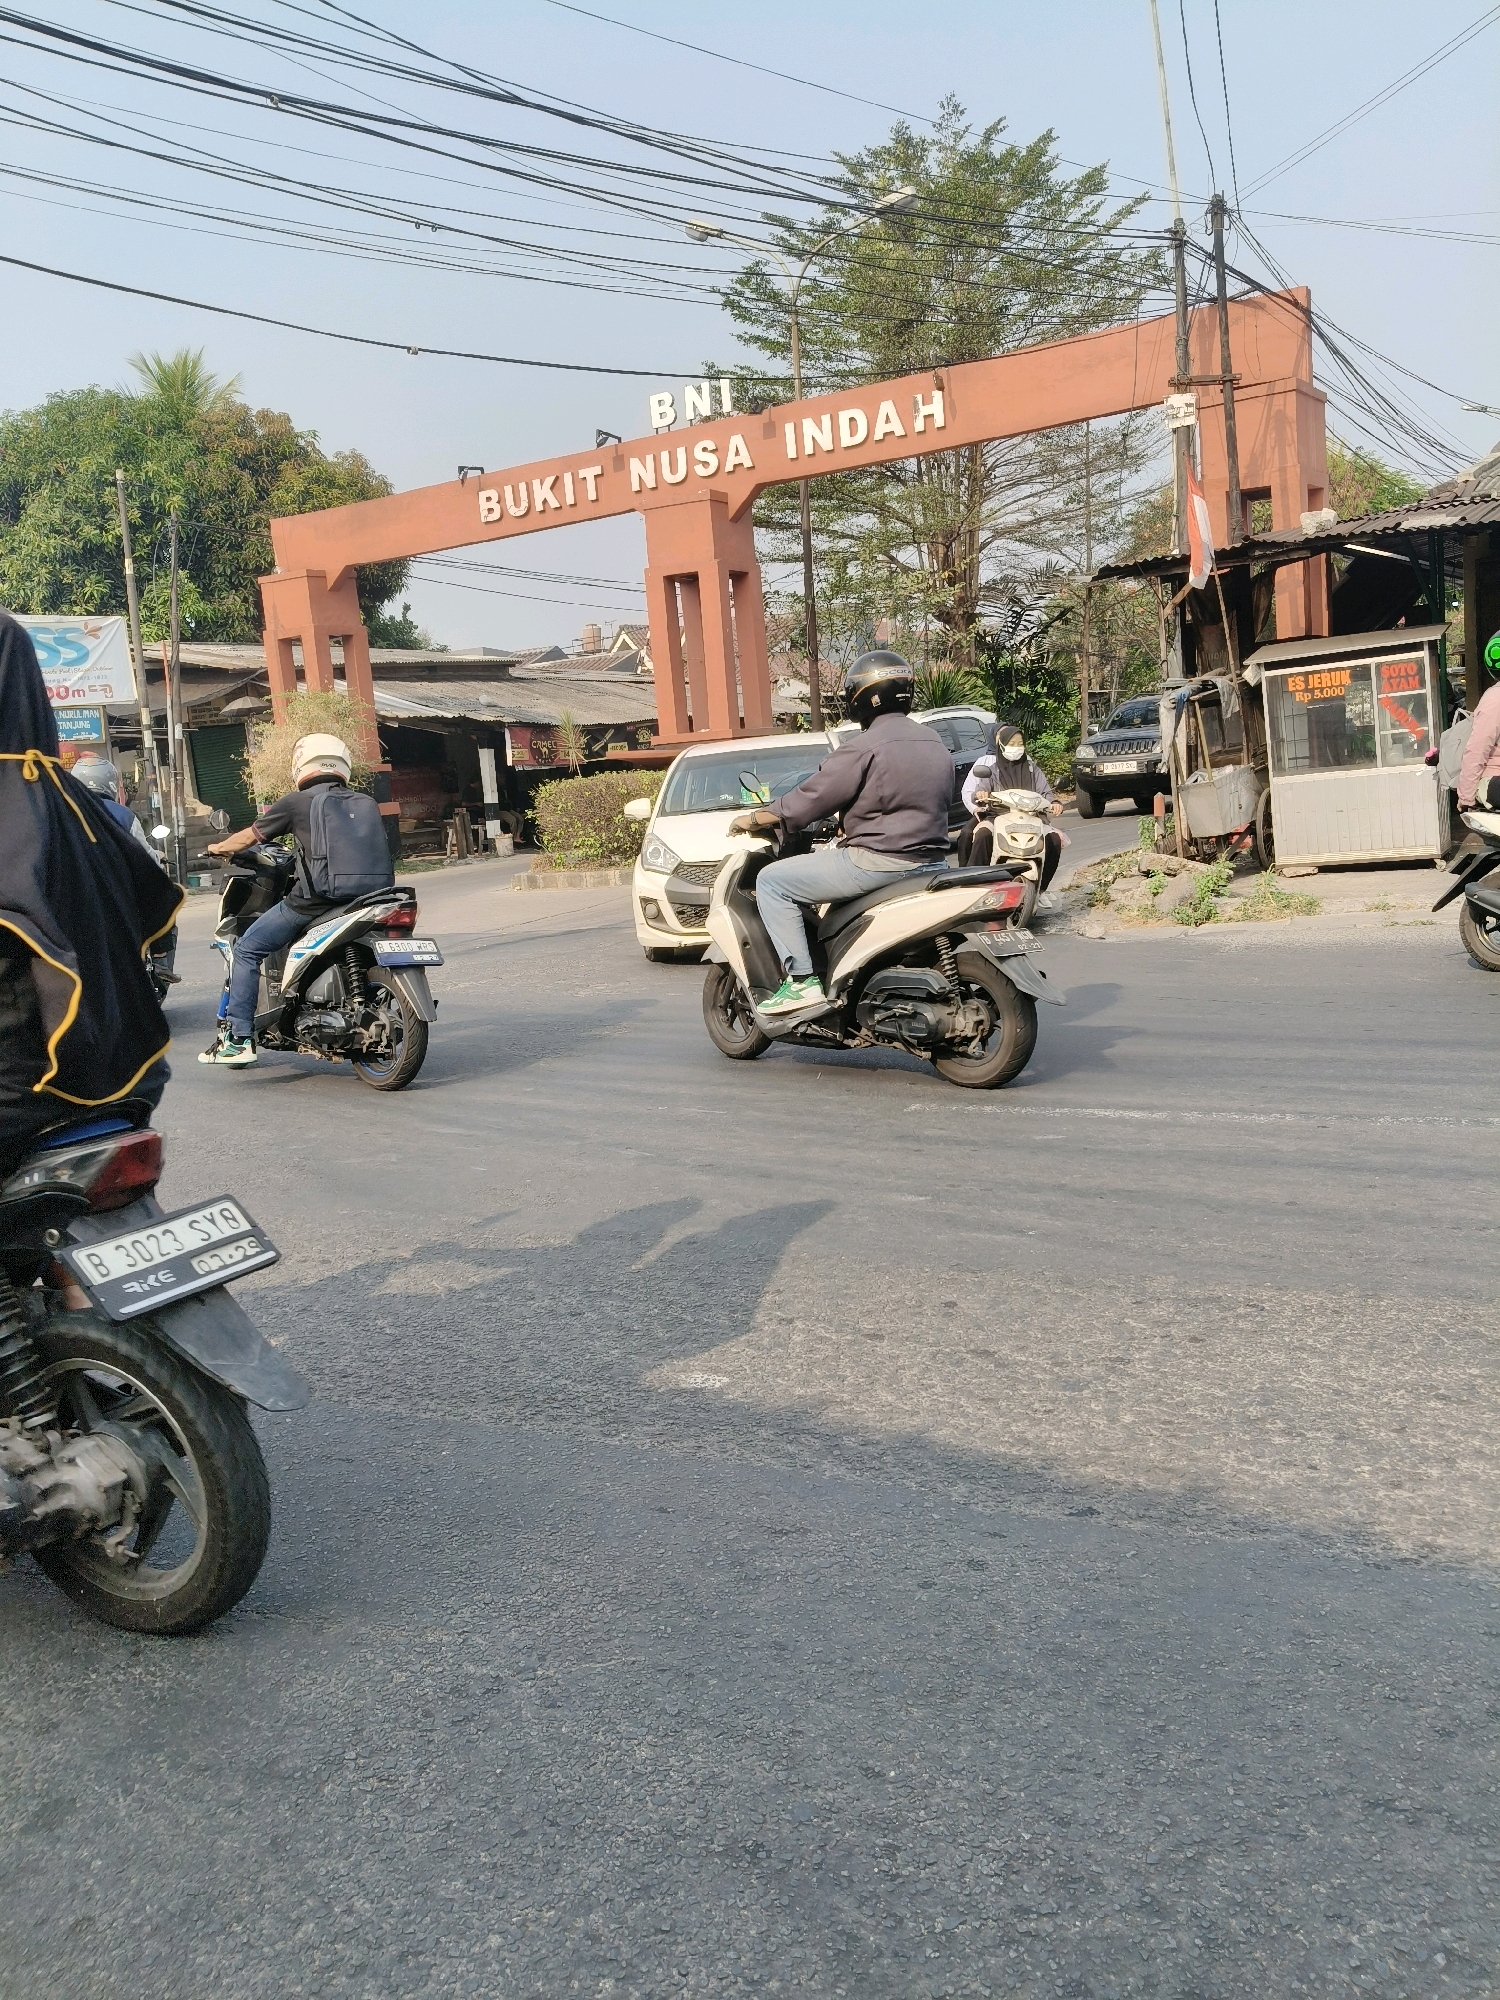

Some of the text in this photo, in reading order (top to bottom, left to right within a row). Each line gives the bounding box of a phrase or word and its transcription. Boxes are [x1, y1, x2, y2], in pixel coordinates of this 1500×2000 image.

[649, 376, 733, 429] BNI
[478, 390, 946, 523] BUKIT NUSA INDAH
[1381, 662, 1418, 678] SOTO
[1288, 669, 1352, 692] ES JERUK
[1381, 676, 1420, 693] AYAM
[1295, 686, 1345, 703] Rp 5.000
[57, 721, 90, 730] TANJUNG
[531, 740, 557, 749] CAMEL
[378, 943, 384, 952] B
[980, 936, 991, 945] B
[85, 1252, 110, 1278] B
[114, 1228, 184, 1268] 3023
